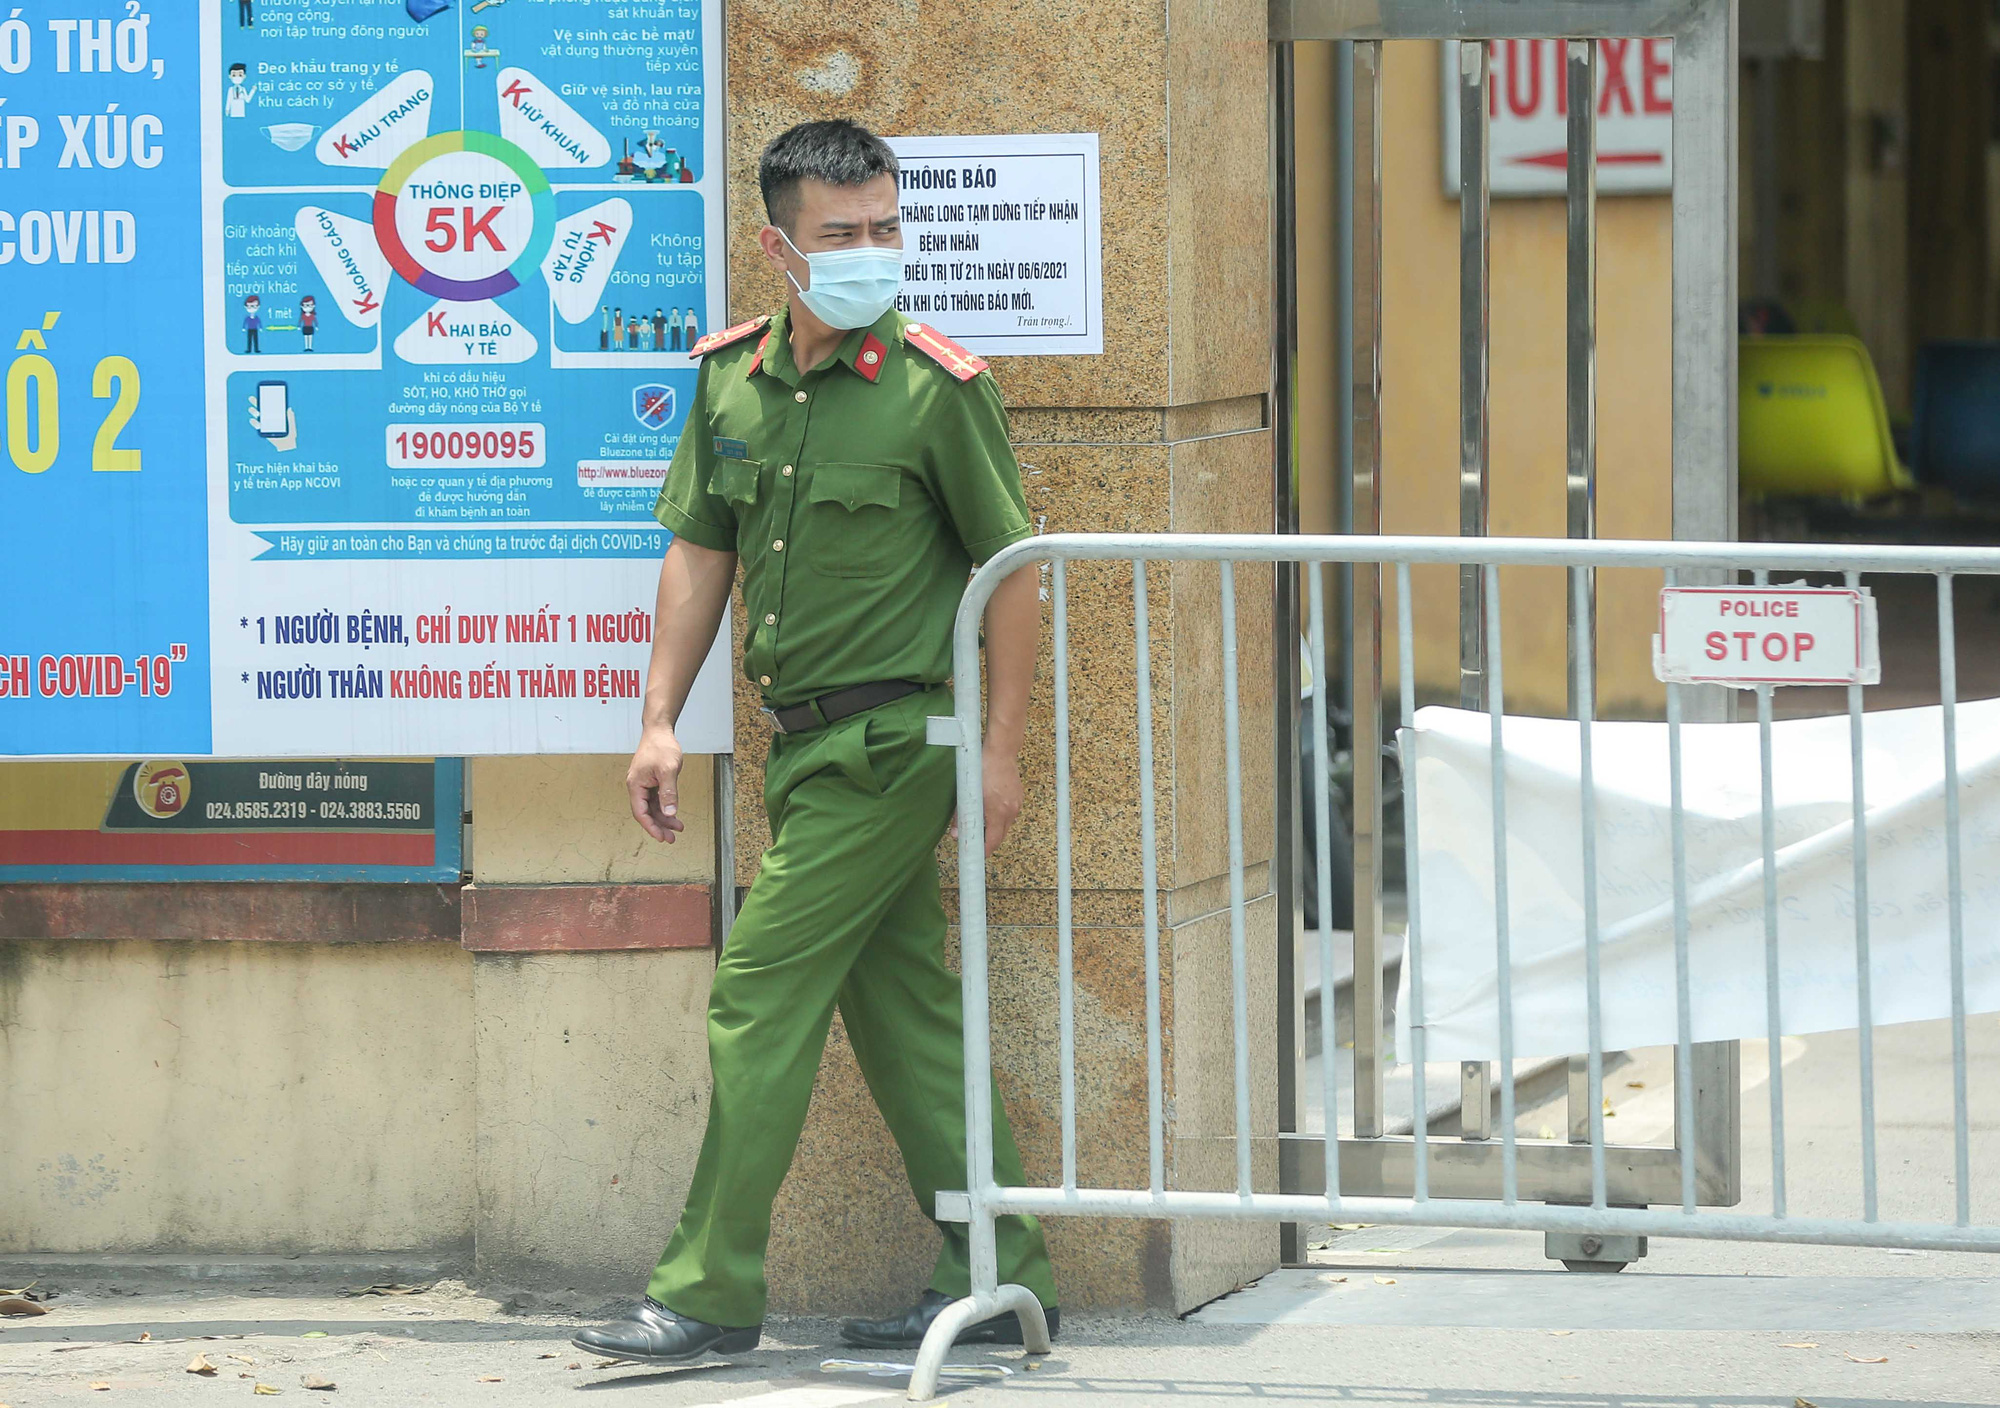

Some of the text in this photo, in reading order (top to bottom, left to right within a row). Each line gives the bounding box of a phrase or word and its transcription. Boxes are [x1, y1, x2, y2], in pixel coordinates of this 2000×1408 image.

[261, 10, 333, 24] công cộng,
[608, 7, 628, 18] sát
[678, 7, 698, 20] tay
[49, 0, 165, 79] THỞ,
[261, 25, 428, 39] nơi tập trung đông người
[554, 29, 572, 42] Vệ
[577, 29, 607, 40] sinh
[612, 30, 637, 41] các
[642, 27, 659, 40] bề
[258, 59, 400, 76] Đeo khẩu trang y tế
[646, 58, 699, 74] tiếp xúc
[1597, 38, 1672, 116] XE
[502, 78, 544, 123] KHỬ
[561, 83, 701, 98] Giữ vệ sinh, lau rửa
[259, 95, 334, 109] khu cách ly
[379, 88, 430, 128] TRANG
[602, 97, 618, 110] và
[644, 99, 669, 110] nhà
[674, 99, 699, 110] cửa
[611, 115, 699, 129] thông thoáng
[0, 98, 164, 169] P XÚC
[900, 164, 997, 190] THÔNG BÁO
[409, 181, 521, 202] THÔNG ĐIỆP
[900, 197, 1079, 225] THĂNG LONG TẠM DỪNG TIẾP NHẬN
[225, 223, 295, 241] Giữ khoảng
[316, 211, 343, 247] CÁCH
[424, 206, 507, 253] 5K
[246, 243, 296, 256] cách khi
[562, 231, 582, 250] TỤ
[651, 234, 701, 250] Không
[919, 230, 979, 255] BỆNH NHÂN
[569, 221, 617, 284] KHÔNG
[657, 252, 702, 268] tụ tập
[227, 260, 296, 278] tiếp xúc với
[904, 258, 1067, 285] ĐIỀU TRỊ TỪ 21h NGÀY 06/6/2021
[228, 281, 297, 298] người khác
[611, 271, 702, 288] đông người
[914, 294, 930, 311] KHI
[934, 290, 948, 311] CÓ
[951, 291, 984, 311] THÔNG
[988, 290, 1007, 311] BÁO
[1011, 288, 1035, 310] MỚI.
[427, 311, 512, 337] KHAI BÁO
[465, 343, 475, 355] Y
[92, 355, 142, 472] 2
[396, 431, 535, 459] 19009095
[281, 534, 660, 555] Hãy giữ an toàn cho Bạn và chúng ta trước đại dịch COVID-19
[1720, 599, 1799, 617] POLICE
[256, 604, 651, 650] 1 NGƯỜI BỆNH, CHỈ DUY NHẤT 1 NGƯỜI
[1705, 631, 1816, 662] STOP
[257, 661, 640, 704] NGƯỜI THÂN KHÔNG ĐẾN THĂM BỆNH
[259, 772, 368, 792] Đường dây nóng
[206, 801, 421, 820] 024.8585.2319 024.3883.5560
